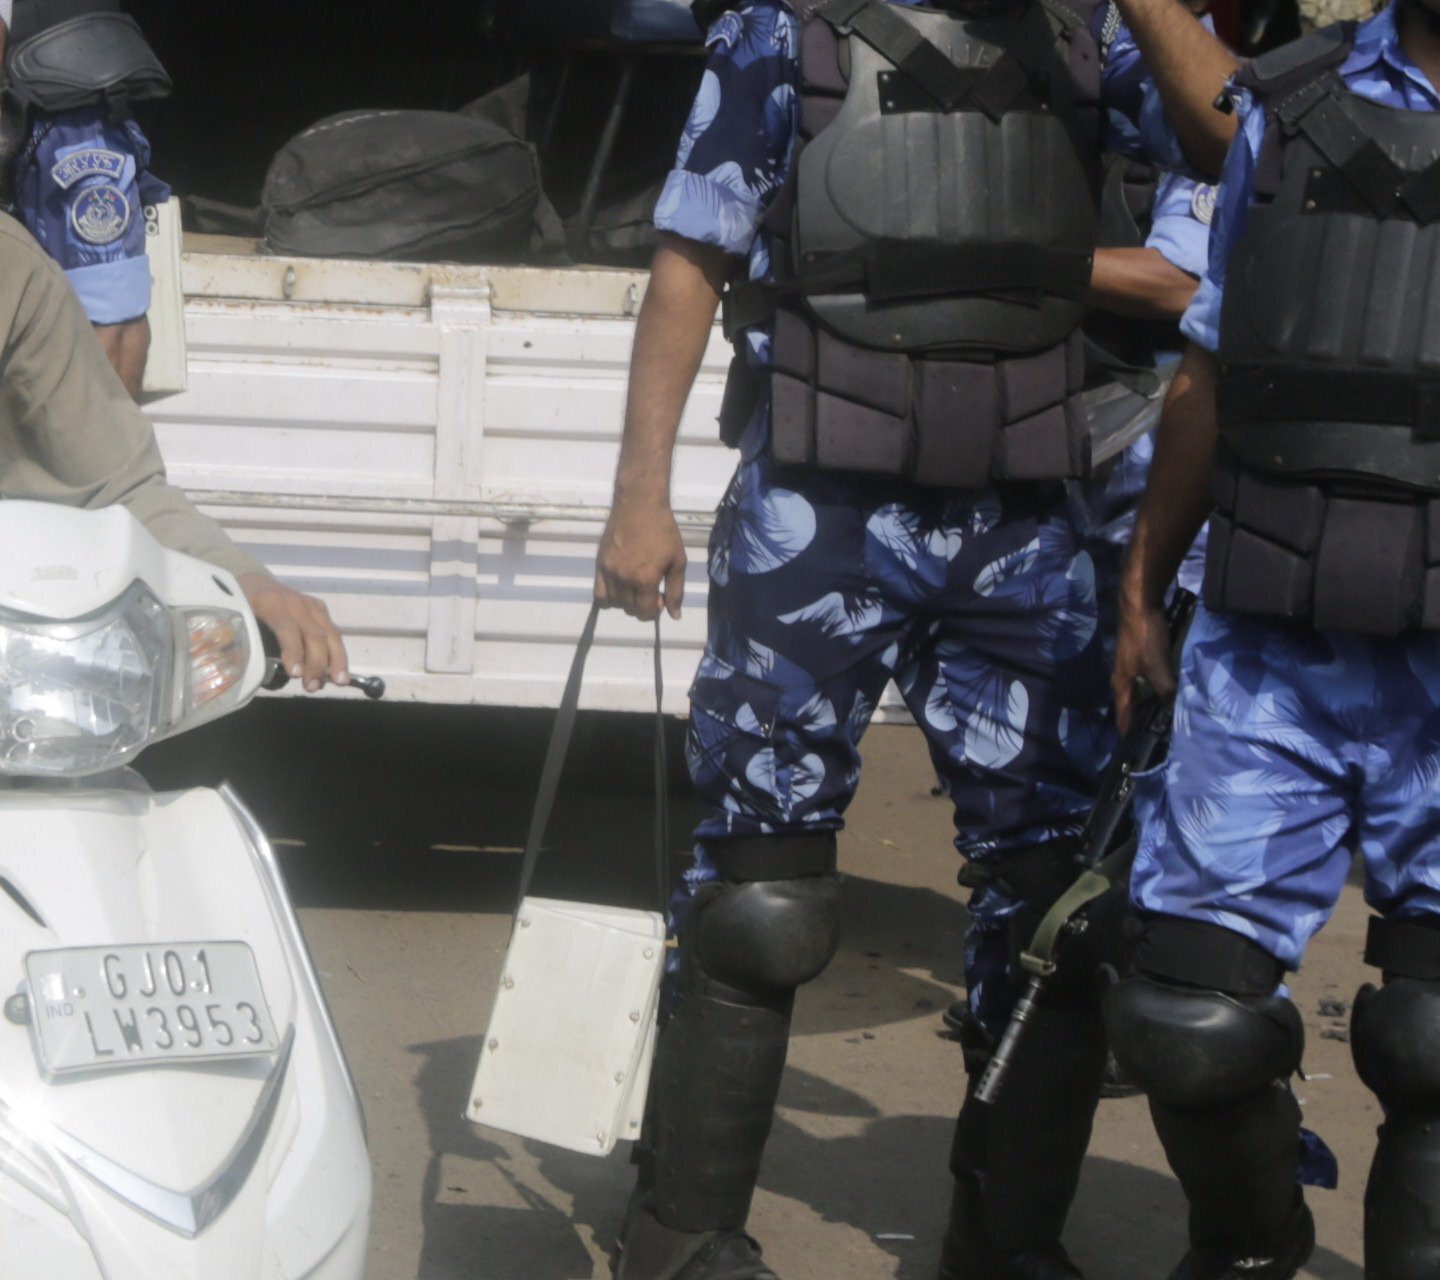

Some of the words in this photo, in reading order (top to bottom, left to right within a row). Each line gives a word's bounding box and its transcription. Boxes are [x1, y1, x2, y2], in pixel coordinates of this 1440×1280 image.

[102, 948, 213, 1000] GJ01
[44, 1003, 75, 1019] IND
[84, 1001, 264, 1057] LW3953
